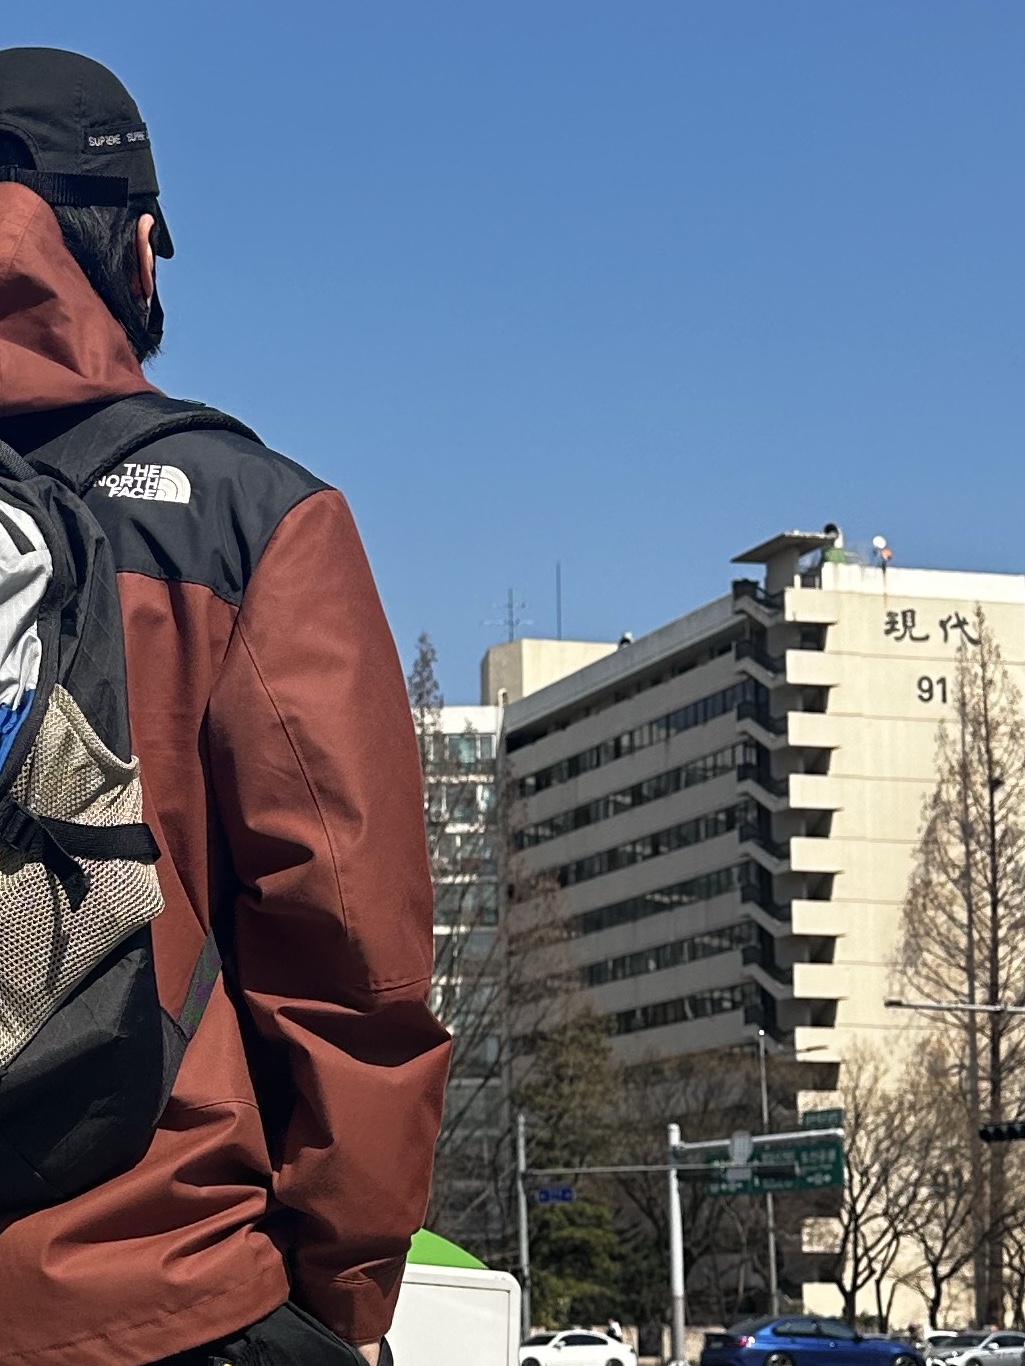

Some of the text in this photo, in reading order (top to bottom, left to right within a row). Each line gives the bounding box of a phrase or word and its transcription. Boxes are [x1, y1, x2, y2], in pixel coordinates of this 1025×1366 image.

[123, 463, 162, 478] THE
[108, 486, 158, 500] FACE
[884, 608, 982, 645] 現代
[917, 675, 948, 704] 91
